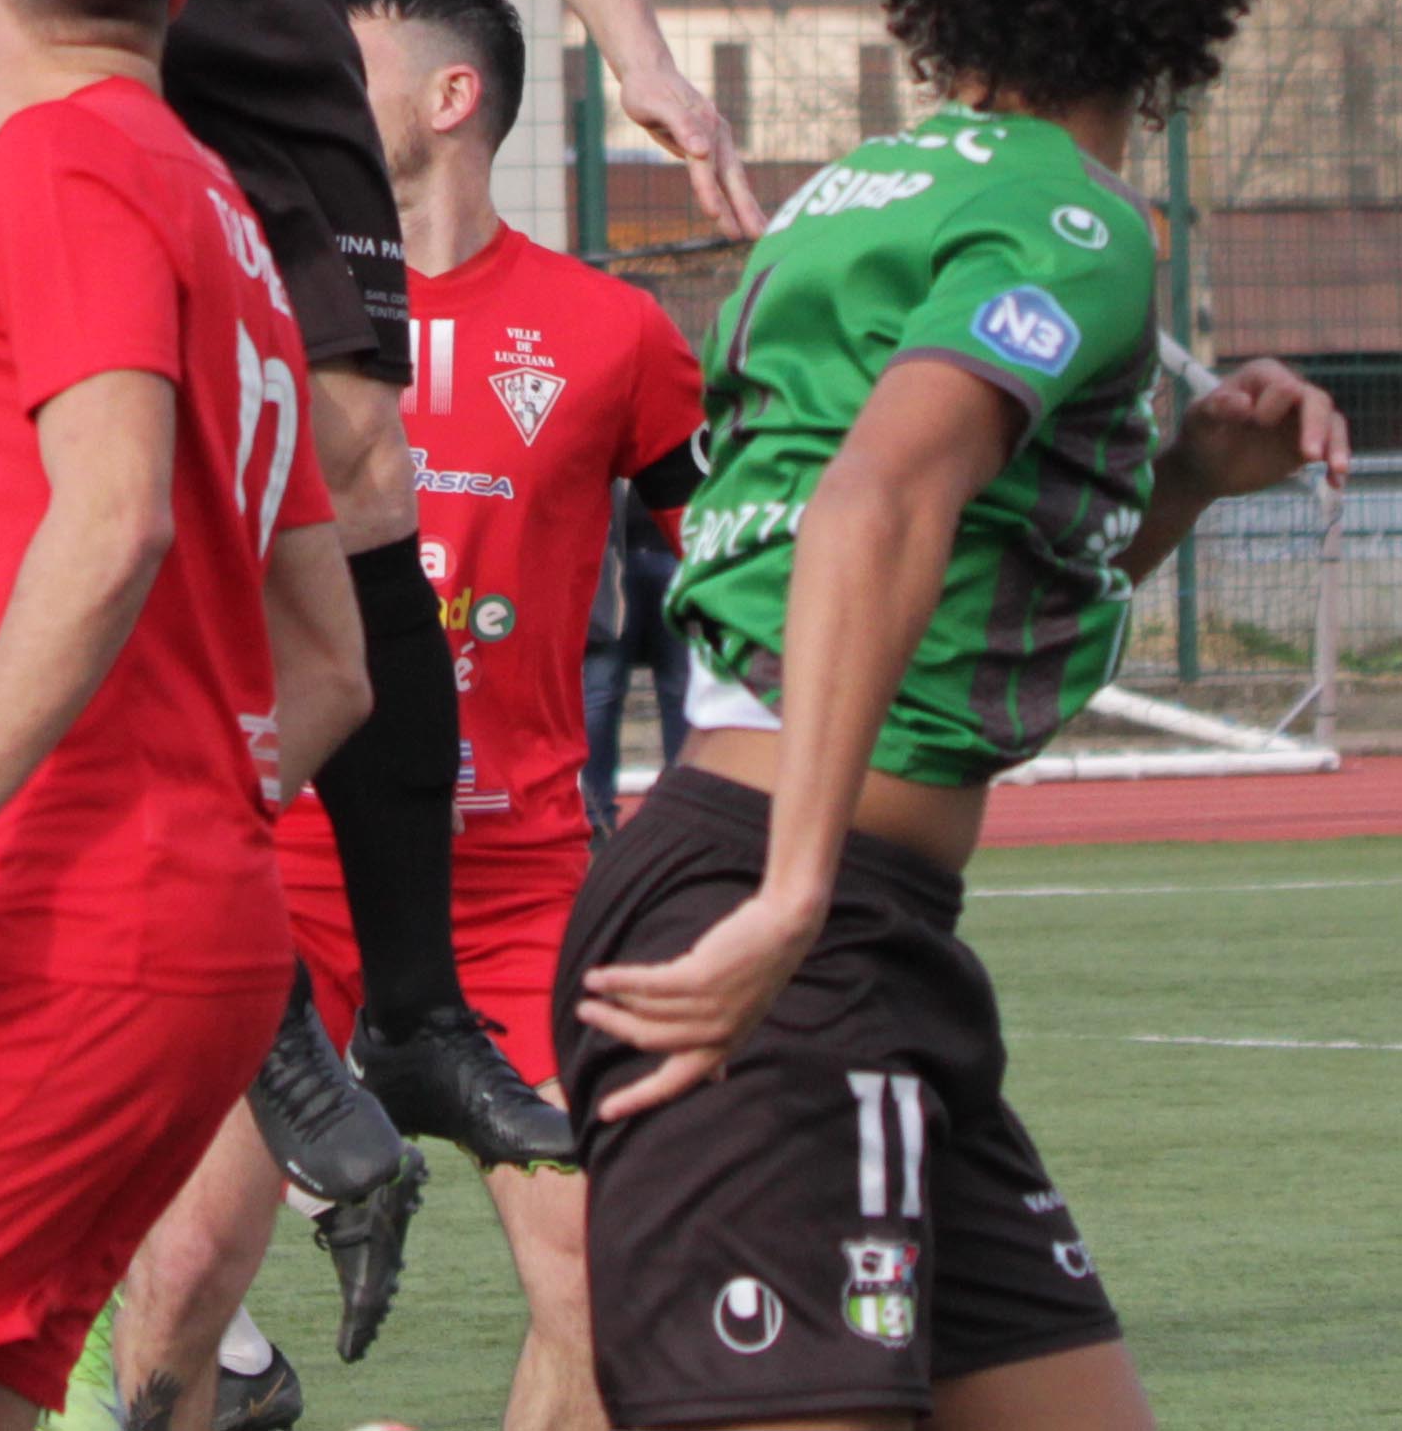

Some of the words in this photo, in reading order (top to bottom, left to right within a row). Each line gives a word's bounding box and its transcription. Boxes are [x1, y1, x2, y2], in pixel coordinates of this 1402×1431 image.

[335, 234, 376, 258] INA
[506, 327, 542, 342] VILLE
[988, 295, 1063, 360] N3
[516, 340, 533, 353] DE
[494, 350, 556, 368] LUCCIANA
[408, 470, 514, 499] RSICA
[845, 1071, 925, 1218] 11
